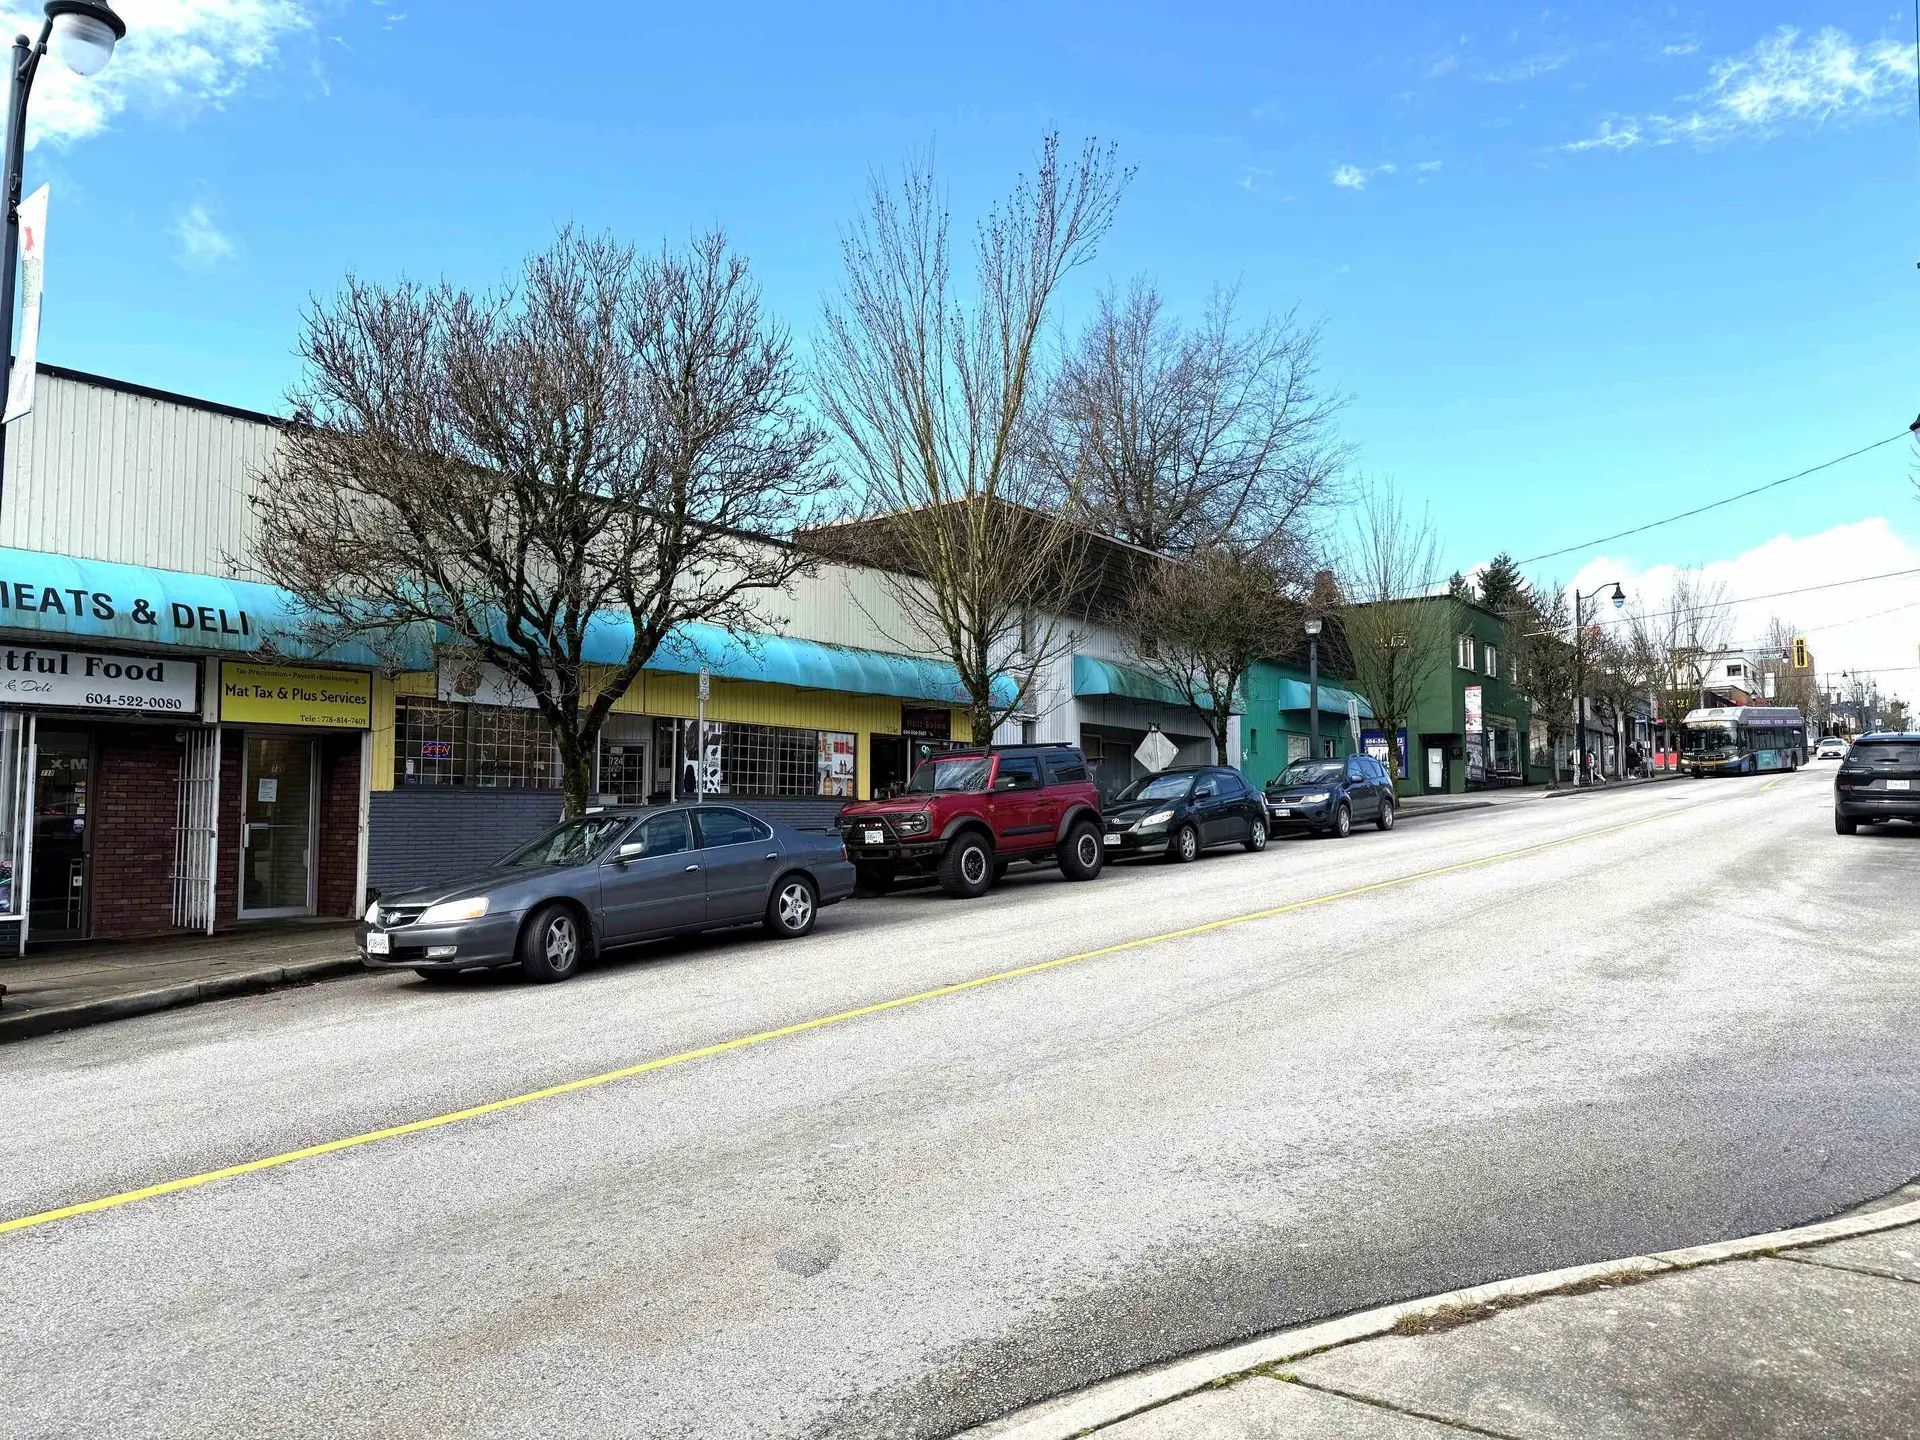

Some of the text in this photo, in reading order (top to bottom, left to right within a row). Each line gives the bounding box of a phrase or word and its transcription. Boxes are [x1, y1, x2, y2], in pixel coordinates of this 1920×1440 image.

[131, 598, 158, 626] &
[171, 602, 249, 636] DELI
[0, 650, 164, 683] tful Food
[292, 672, 316, 680] Payroll
[4, 679, 53, 692] & Deli
[225, 683, 367, 704] Mat Tax & Plus Services
[85, 693, 182, 709] 604-522-0080
[321, 716, 366, 725] 778-814-7401
[420, 745, 450, 755] OPEN
